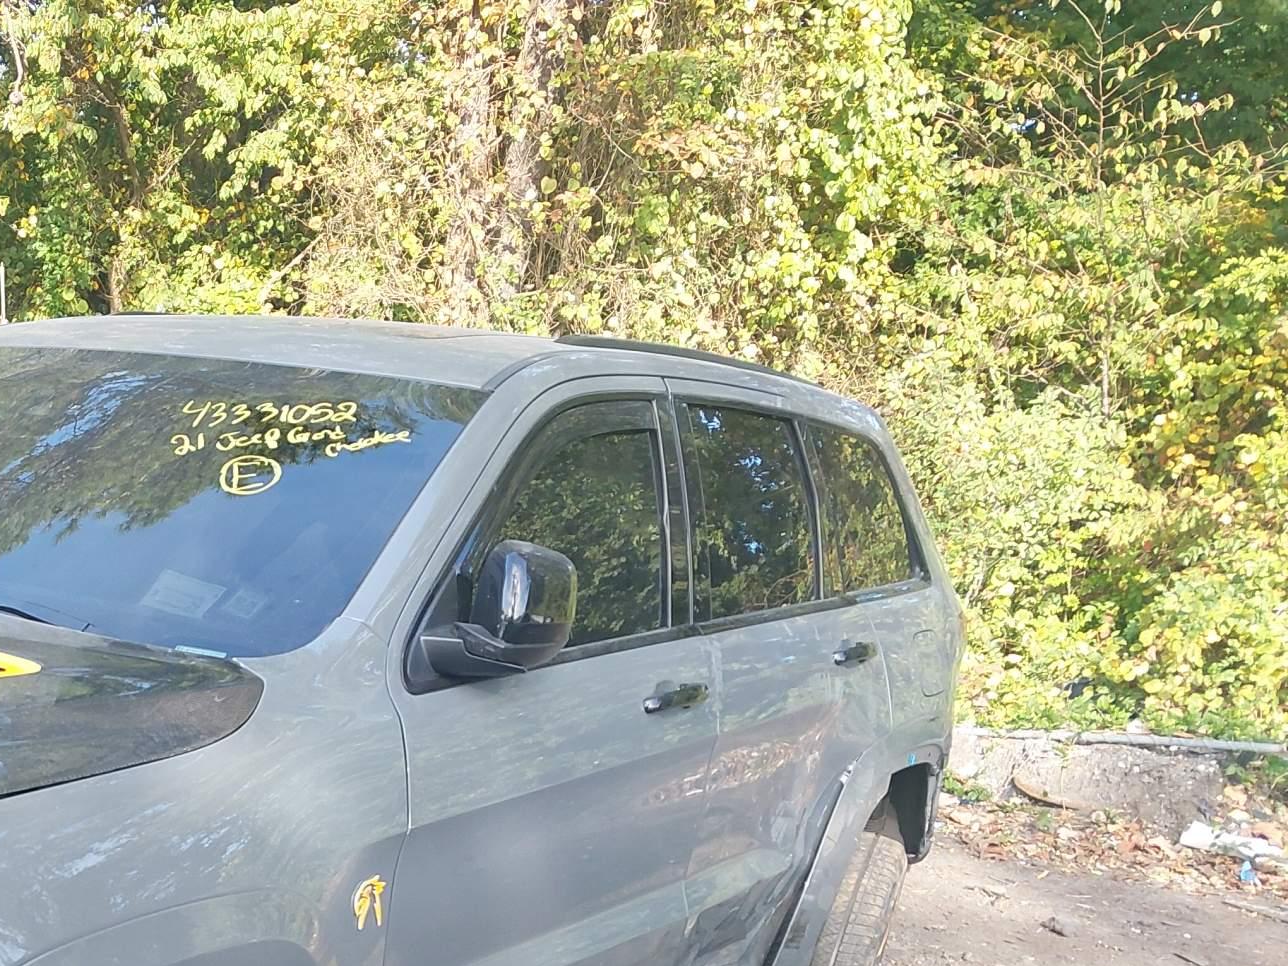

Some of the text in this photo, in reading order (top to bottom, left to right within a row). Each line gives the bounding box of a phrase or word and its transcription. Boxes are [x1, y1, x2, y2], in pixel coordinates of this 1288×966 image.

[182, 400, 358, 428] 43331052
[170, 433, 205, 456] 21
[216, 428, 280, 450] Jeep
